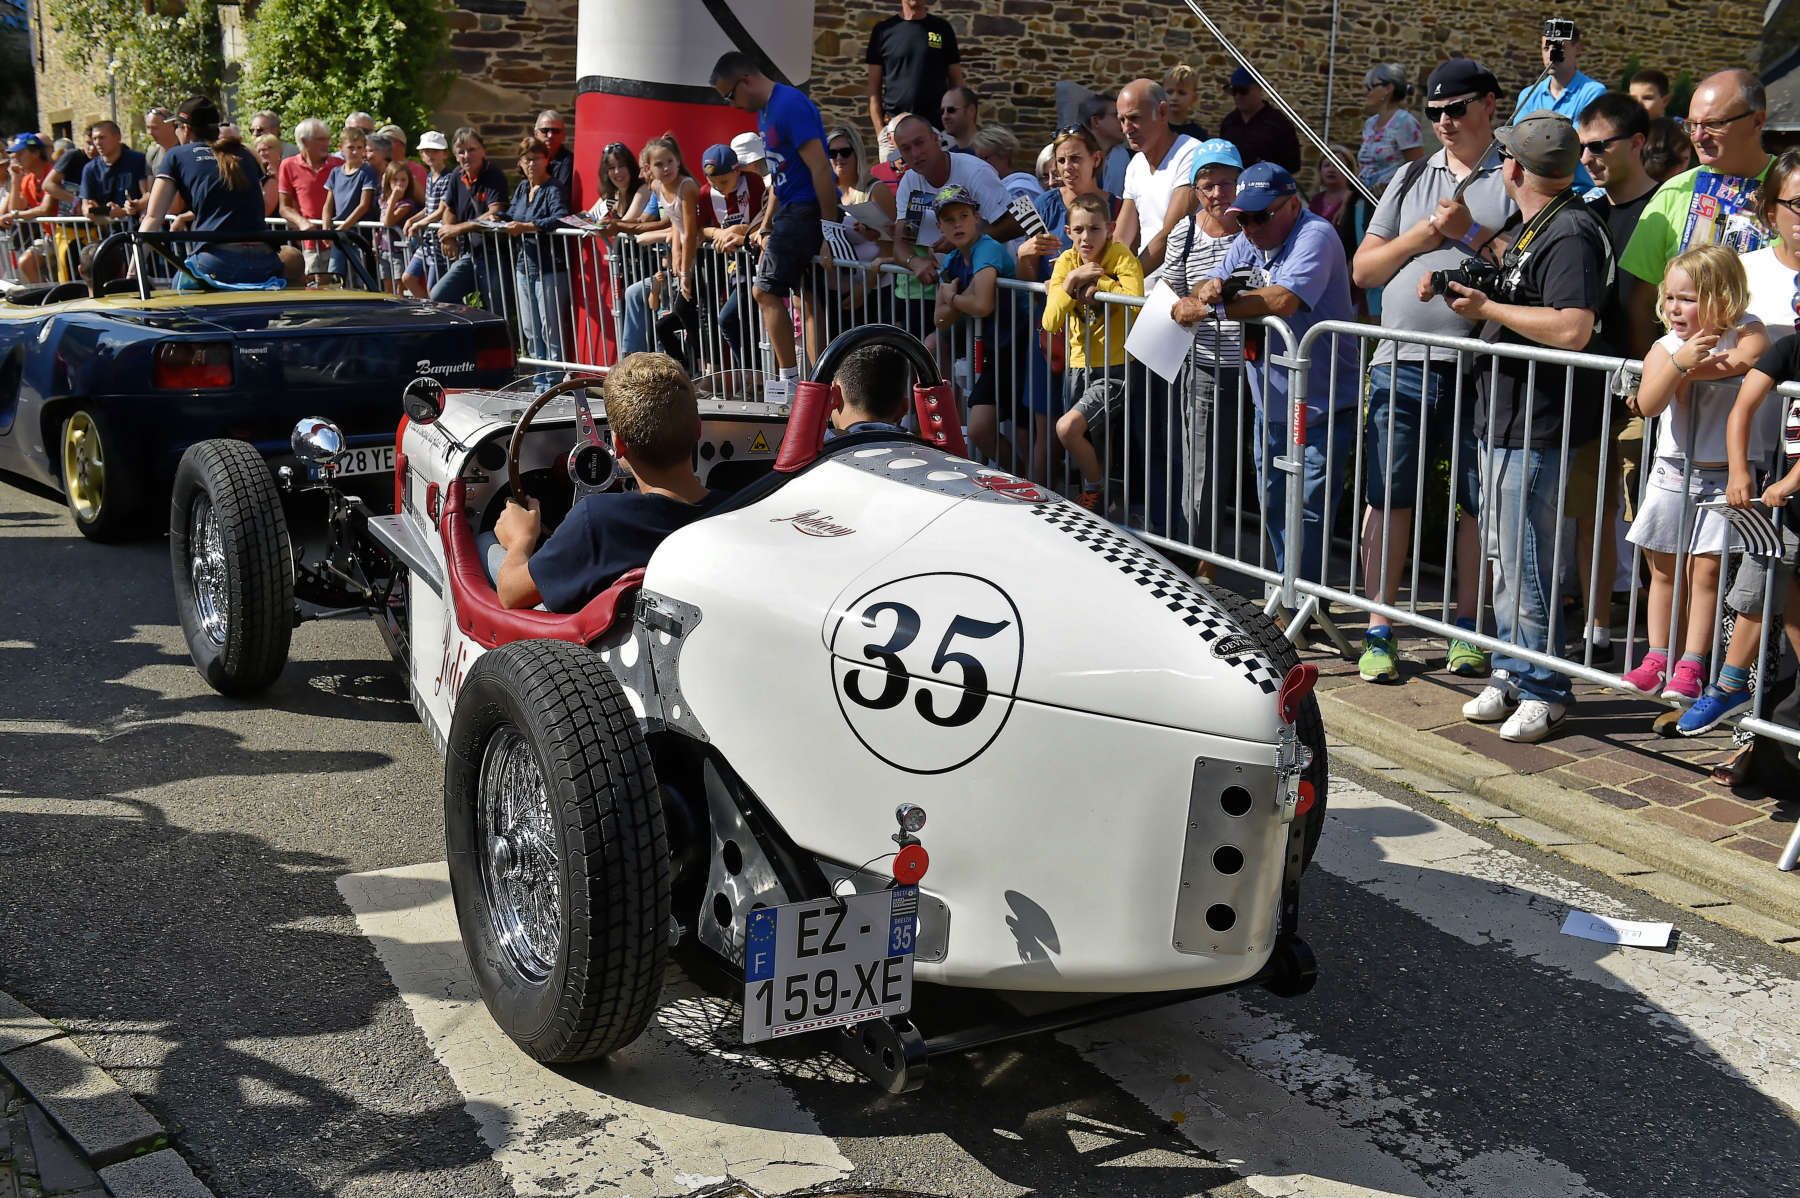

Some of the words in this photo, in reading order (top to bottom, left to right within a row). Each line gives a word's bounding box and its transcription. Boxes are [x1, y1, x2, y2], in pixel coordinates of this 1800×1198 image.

[1517, 230, 1534, 251] Nikon
[415, 359, 475, 377] Barquette
[371, 448, 394, 471] YE
[843, 601, 1011, 728] 35
[797, 905, 849, 959] EZ
[892, 924, 912, 951] 35
[754, 952, 767, 975] F
[755, 956, 904, 1027] 159-XE
[774, 1010, 882, 1035] PODIOCOM
